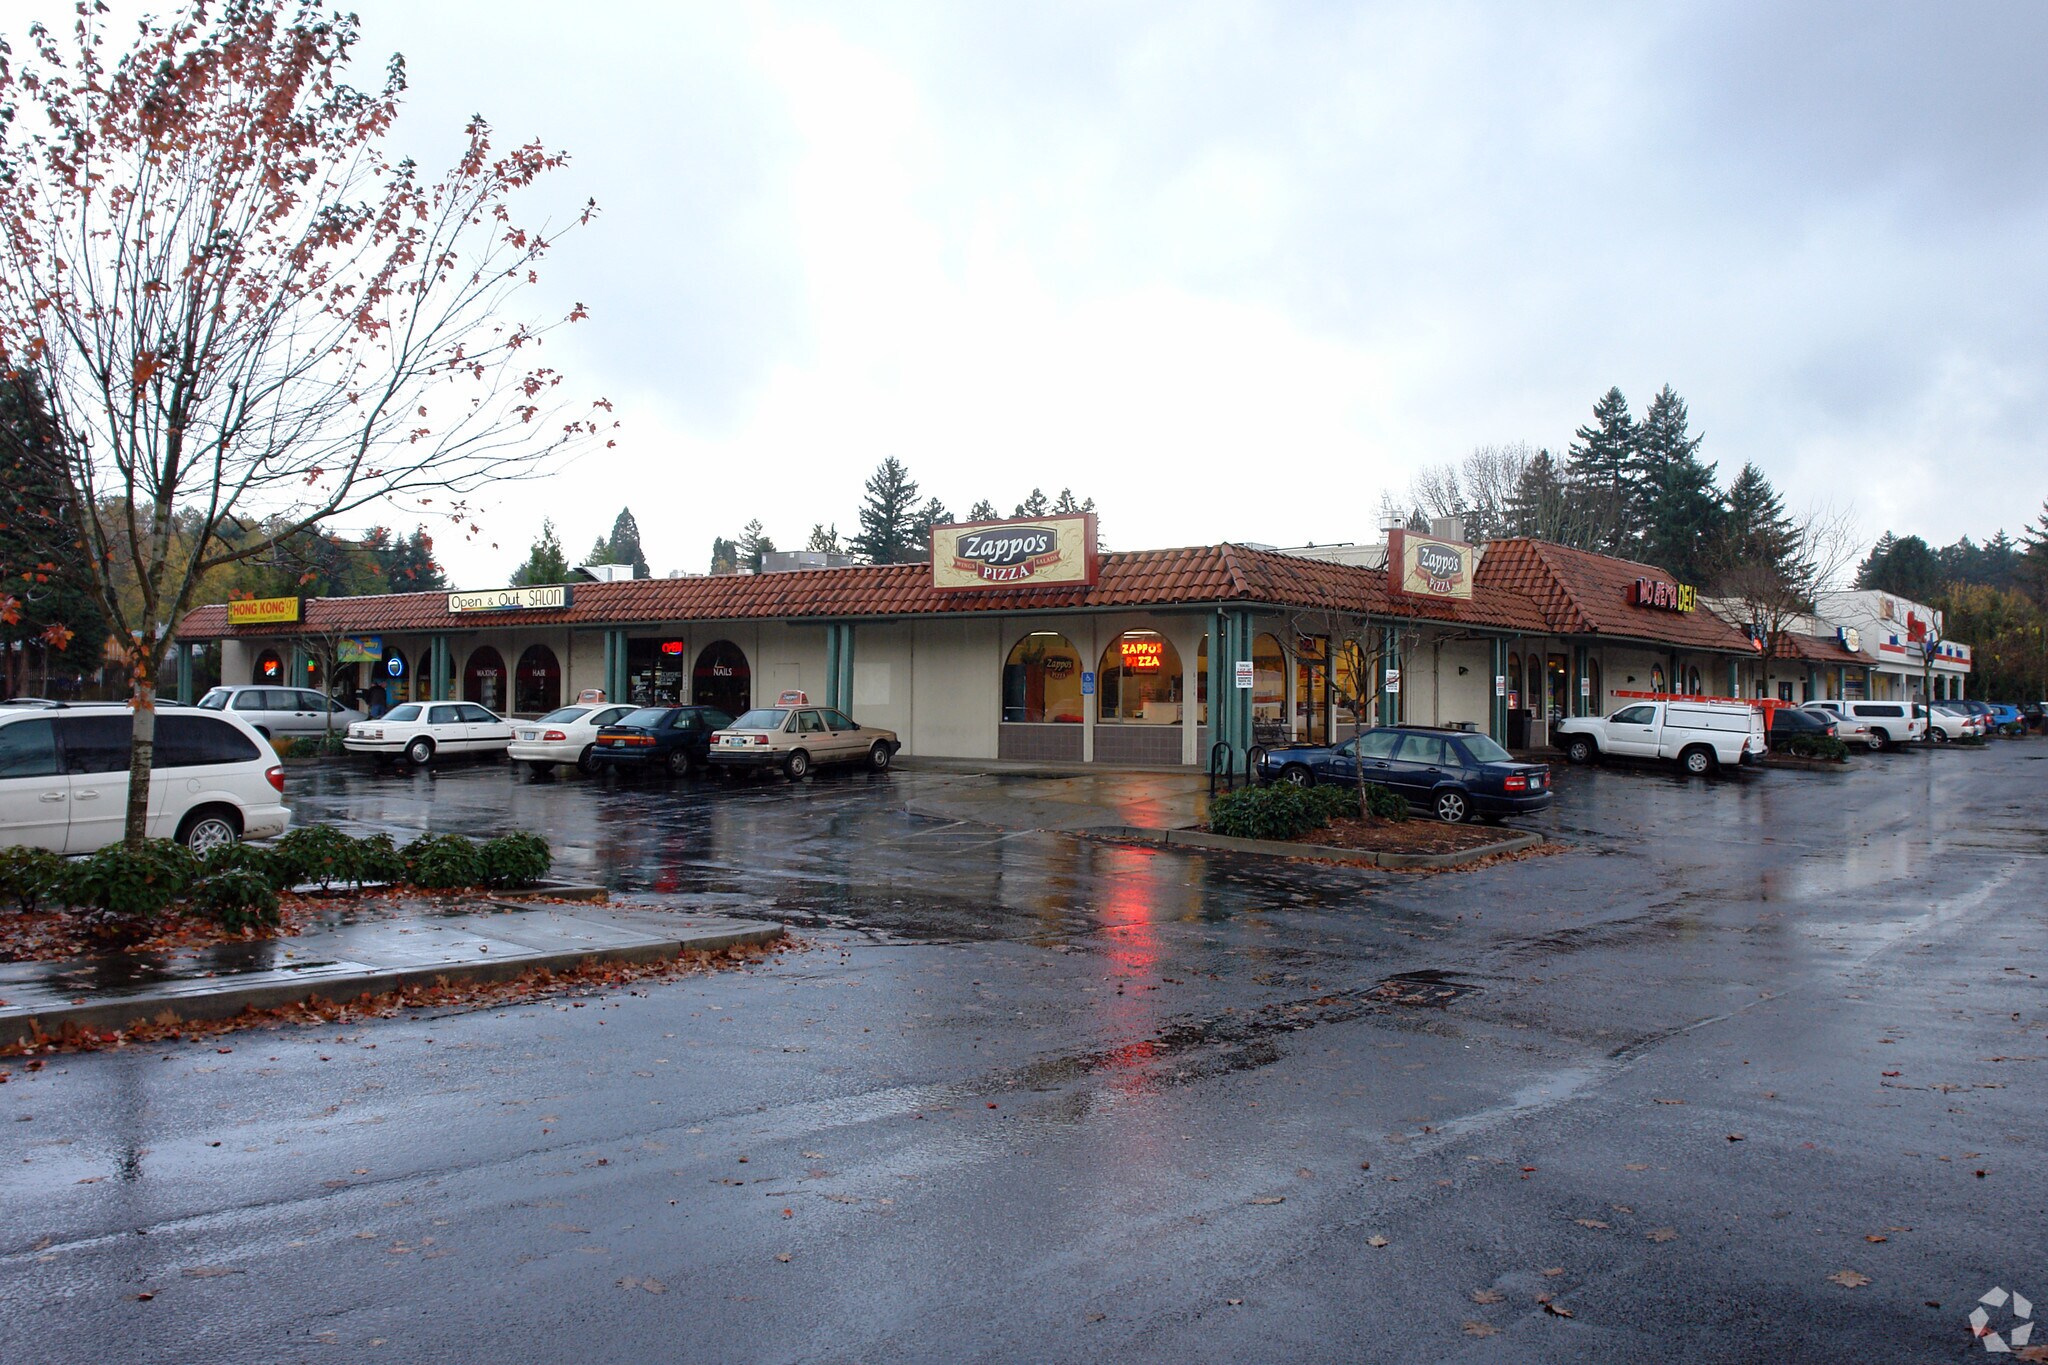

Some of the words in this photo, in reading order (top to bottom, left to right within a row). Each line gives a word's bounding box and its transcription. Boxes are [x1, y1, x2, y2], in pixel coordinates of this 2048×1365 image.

[965, 534, 1048, 563] Zappo's
[956, 561, 975, 570] WINGS
[1036, 555, 1059, 566] SALADS
[1421, 547, 1459, 575] Zappo's
[982, 565, 1030, 581] PIZZA
[1429, 577, 1451, 592] PIZZA
[451, 595, 482, 608] Open
[487, 597, 494, 606] &
[498, 592, 520, 607] Out
[528, 589, 561, 607] SALON
[1677, 583, 1697, 613] DELI
[233, 602, 257, 616] HONG
[260, 600, 285, 615] KONG
[1125, 655, 1160, 667] PIZZA
[476, 669, 498, 677] WAXING
[532, 668, 546, 677] HAIR
[713, 667, 733, 677] NAILS
